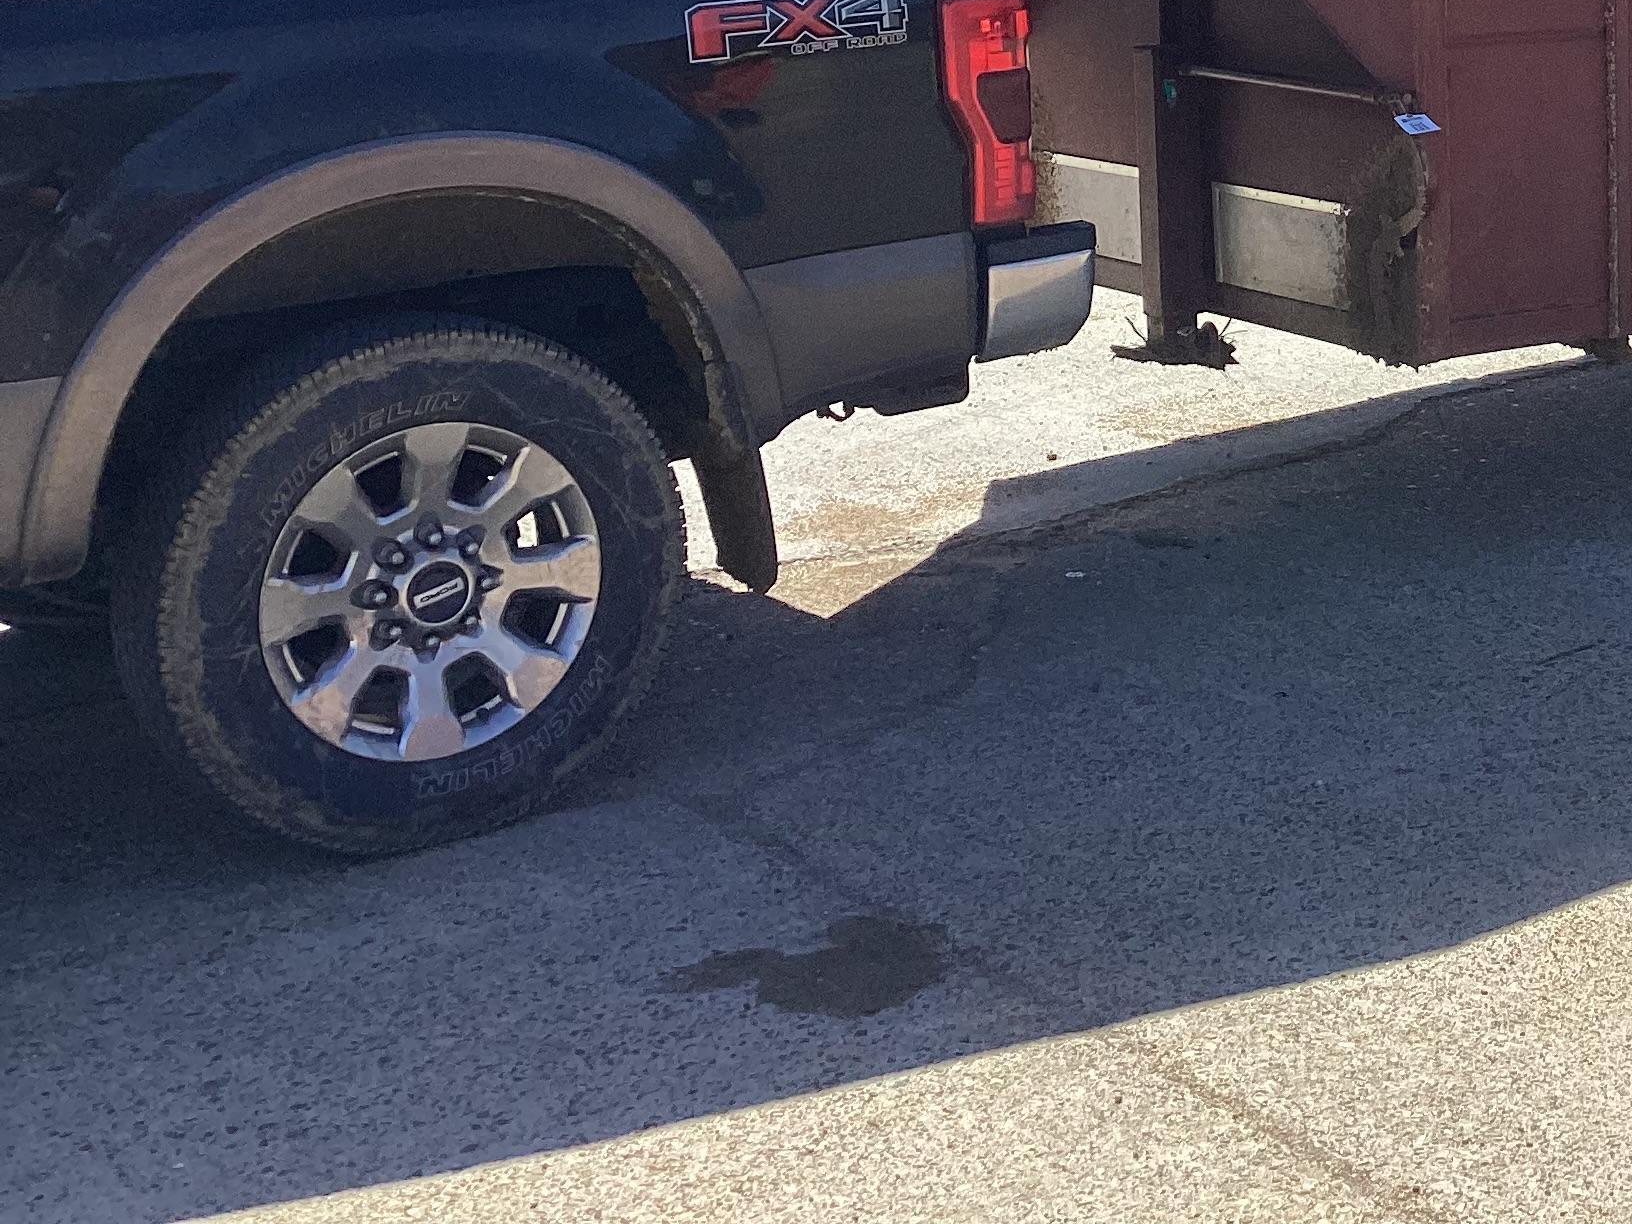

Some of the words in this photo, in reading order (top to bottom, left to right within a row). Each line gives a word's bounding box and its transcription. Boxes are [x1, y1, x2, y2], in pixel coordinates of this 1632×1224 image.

[791, 39, 838, 55] OFF
[847, 33, 908, 49] ROAD
[259, 391, 471, 526] MICHELIN
